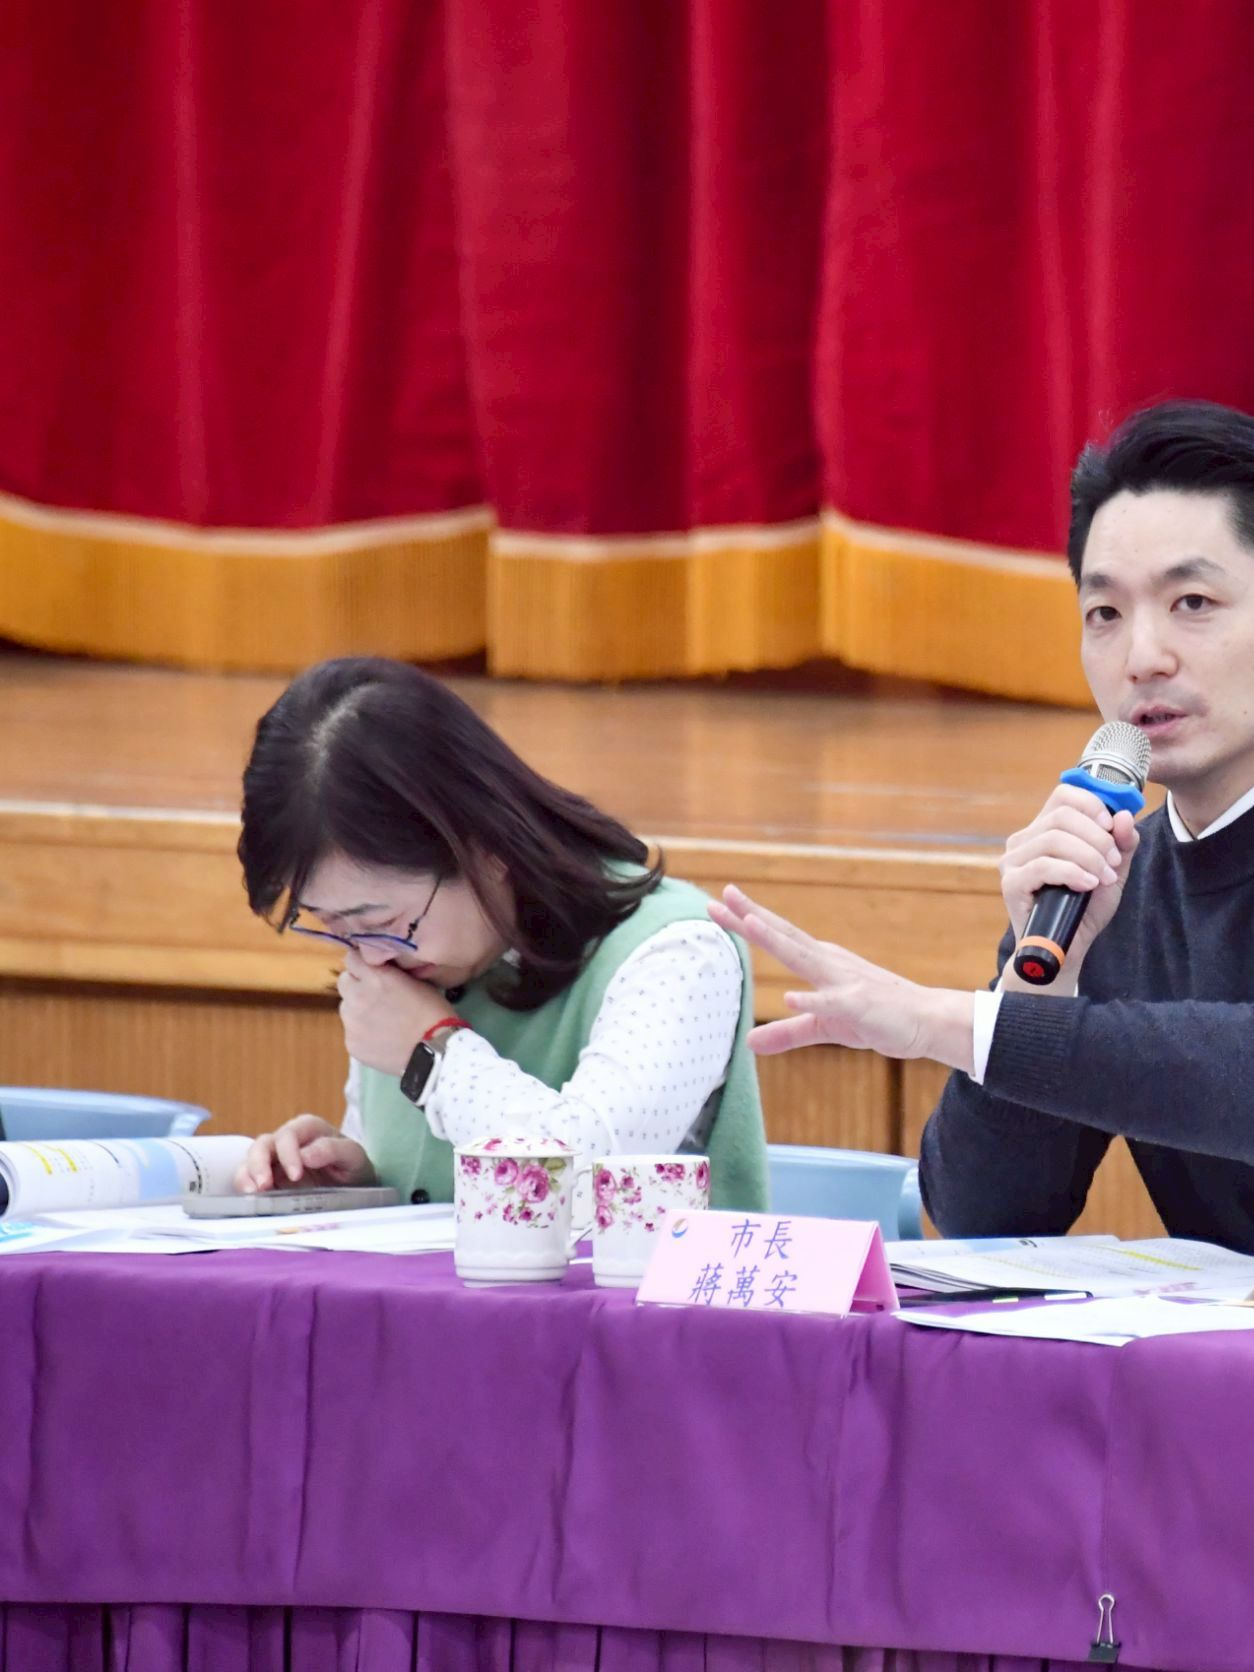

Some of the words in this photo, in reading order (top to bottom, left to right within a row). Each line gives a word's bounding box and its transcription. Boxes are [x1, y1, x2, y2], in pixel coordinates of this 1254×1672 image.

[731, 1218, 793, 1260] 市長
[688, 1263, 798, 1308] 蔣萬安
